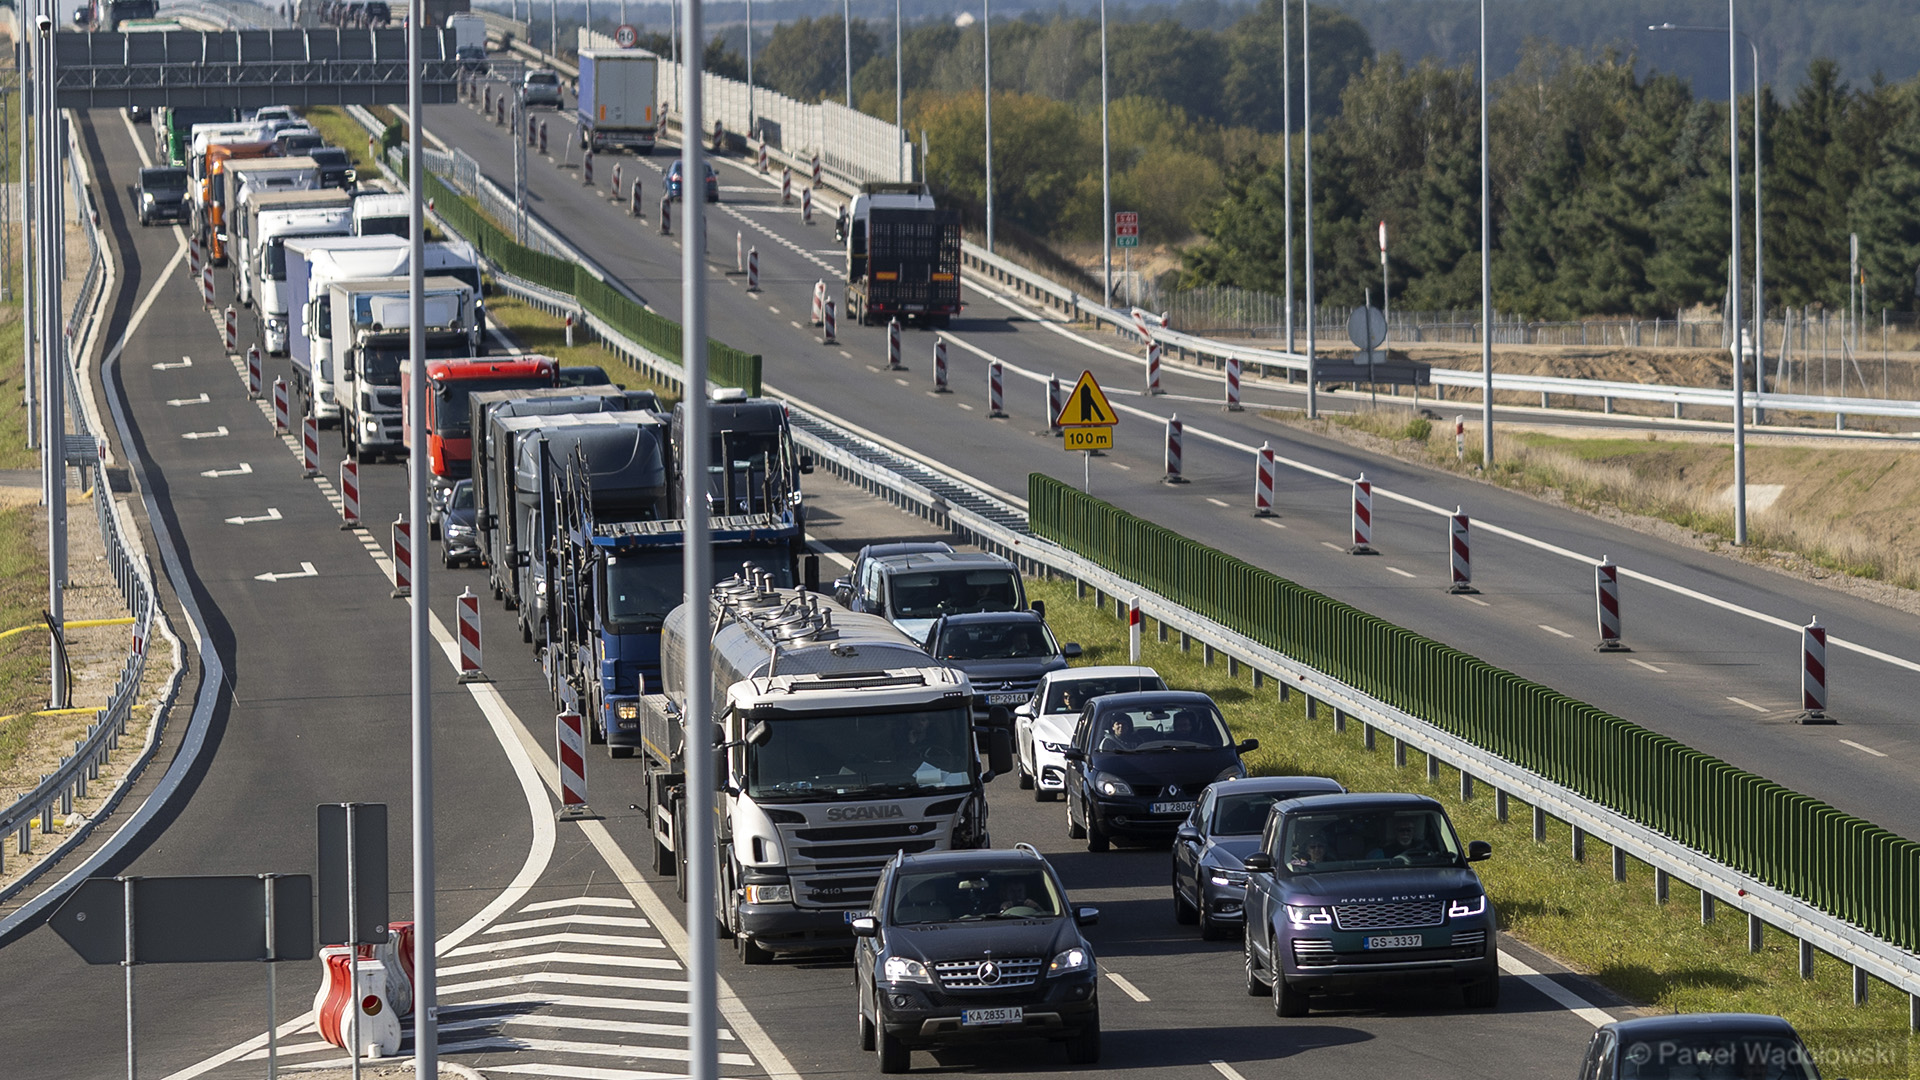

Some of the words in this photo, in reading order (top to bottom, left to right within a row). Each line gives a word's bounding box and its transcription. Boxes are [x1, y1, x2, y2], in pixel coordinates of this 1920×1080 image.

[1070, 432, 1093, 445] 100
[1096, 435, 1107, 444] m
[826, 804, 904, 821] SCANIA
[1371, 936, 1420, 948] GS-3337
